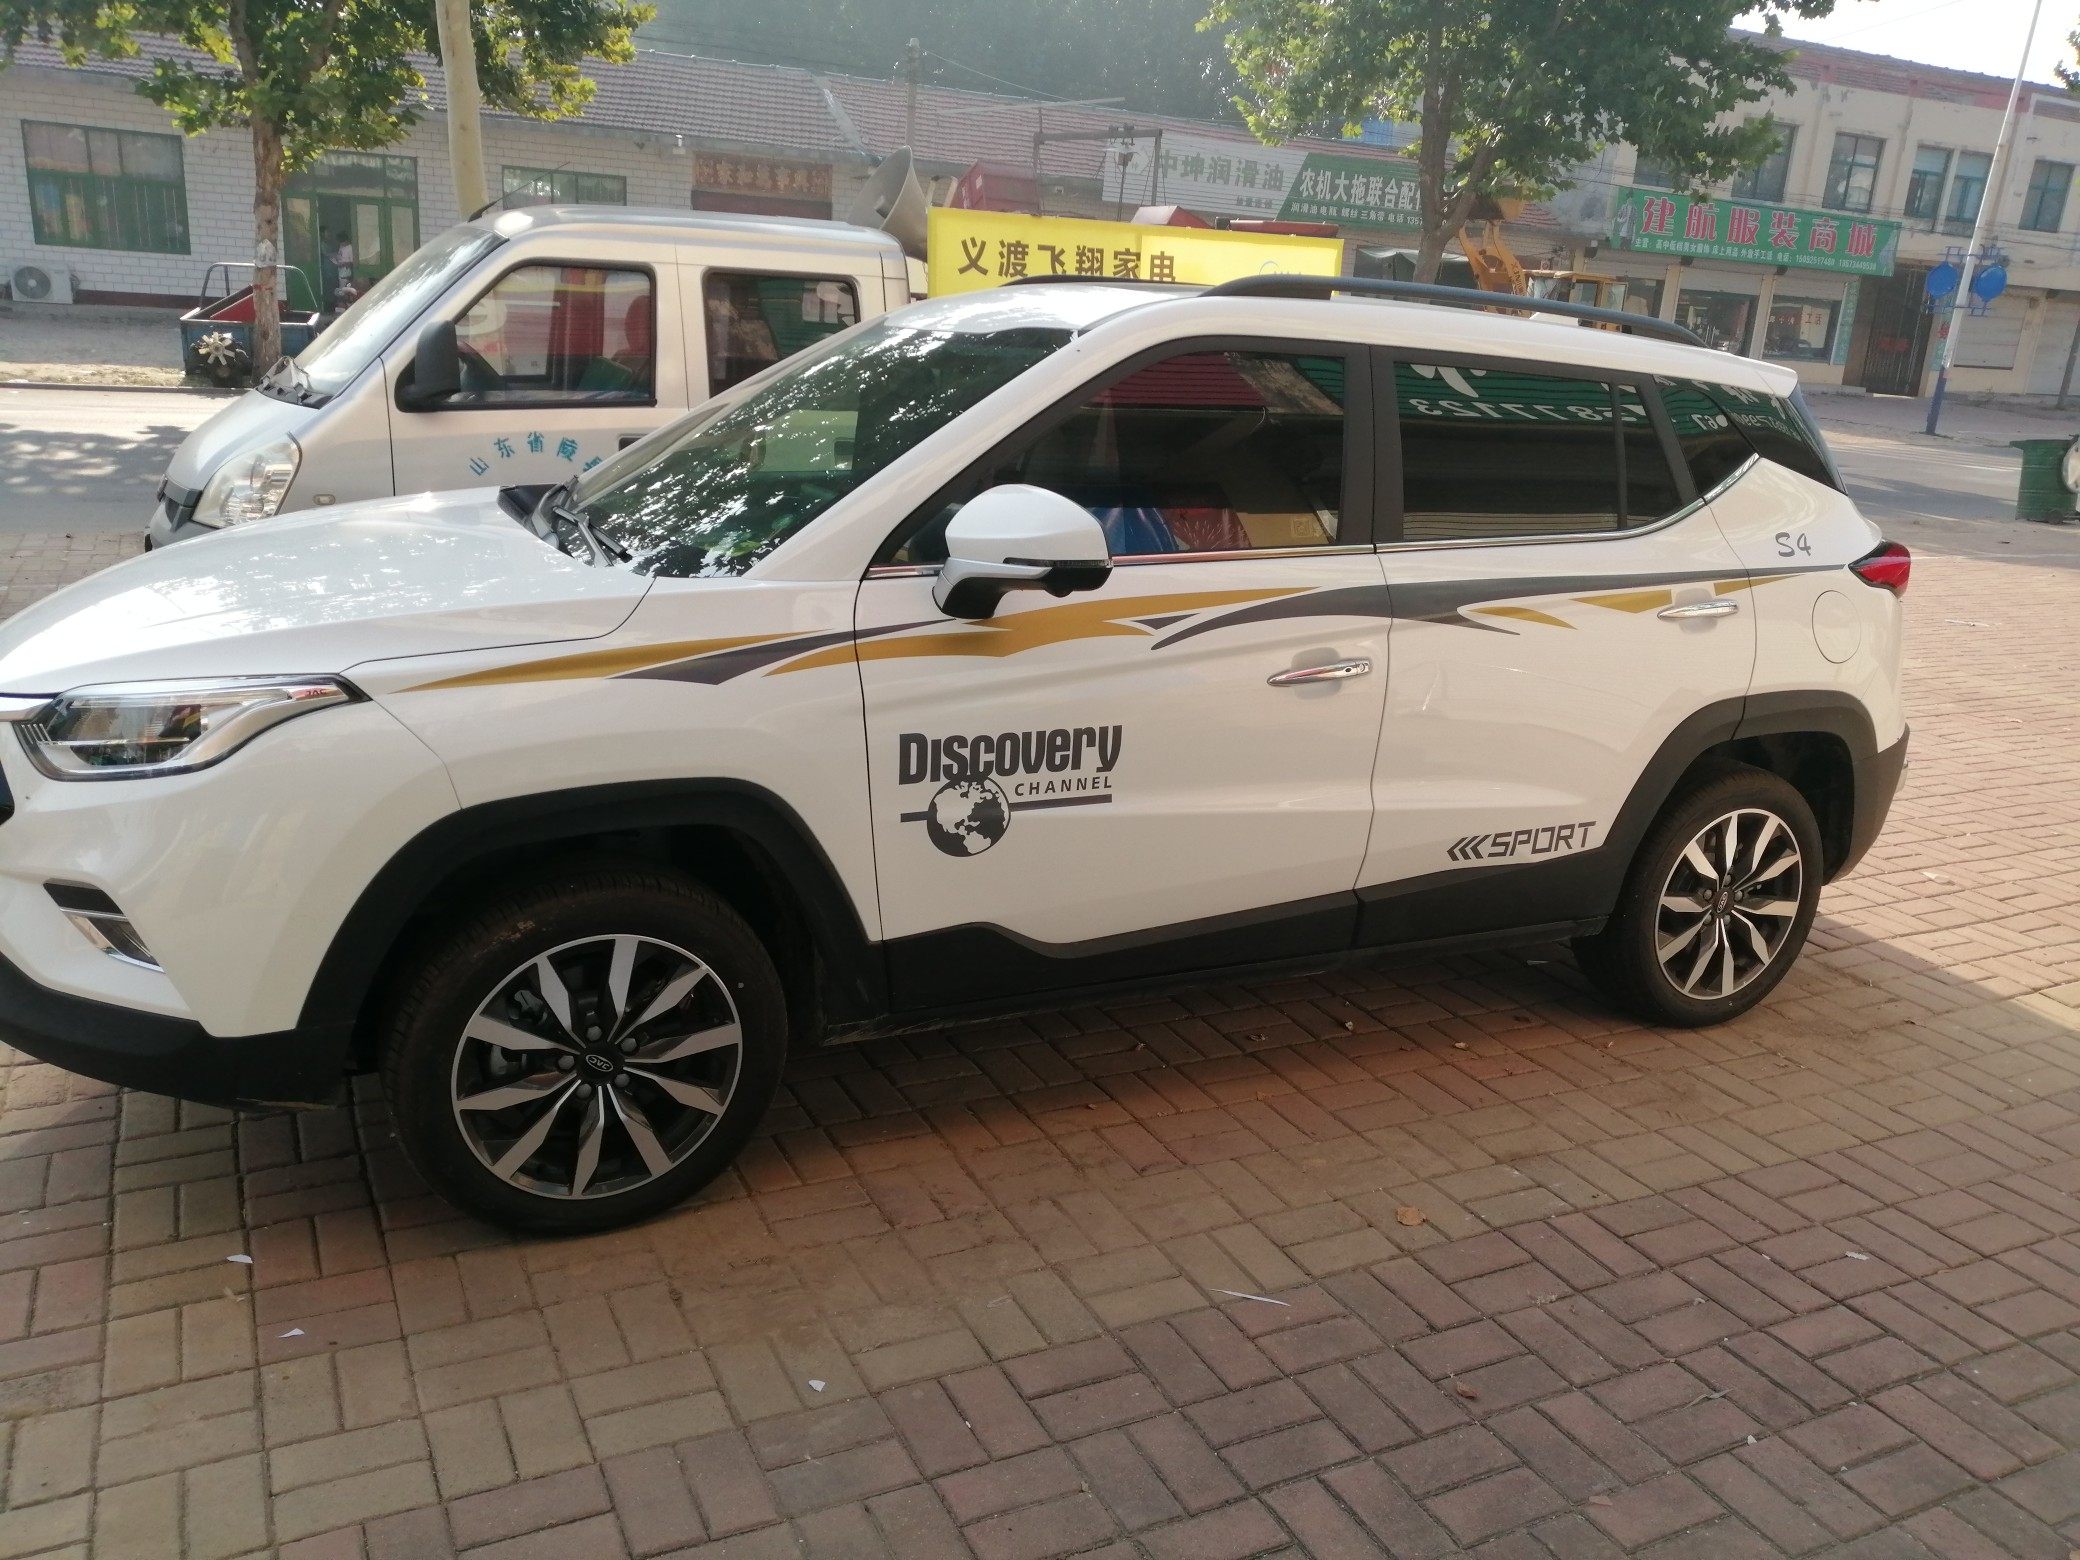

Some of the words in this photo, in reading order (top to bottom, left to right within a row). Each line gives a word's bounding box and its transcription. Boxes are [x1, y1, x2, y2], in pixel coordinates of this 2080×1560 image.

[1388, 213, 1404, 223] 电话
[1641, 196, 1878, 258] 建航服装商城
[957, 237, 1176, 283] 义渡飞翔家电
[1775, 532, 1811, 557] S4
[898, 724, 1122, 785] Discovery
[1014, 776, 1112, 797] CHANNEL
[1487, 821, 1597, 858] SPORT
